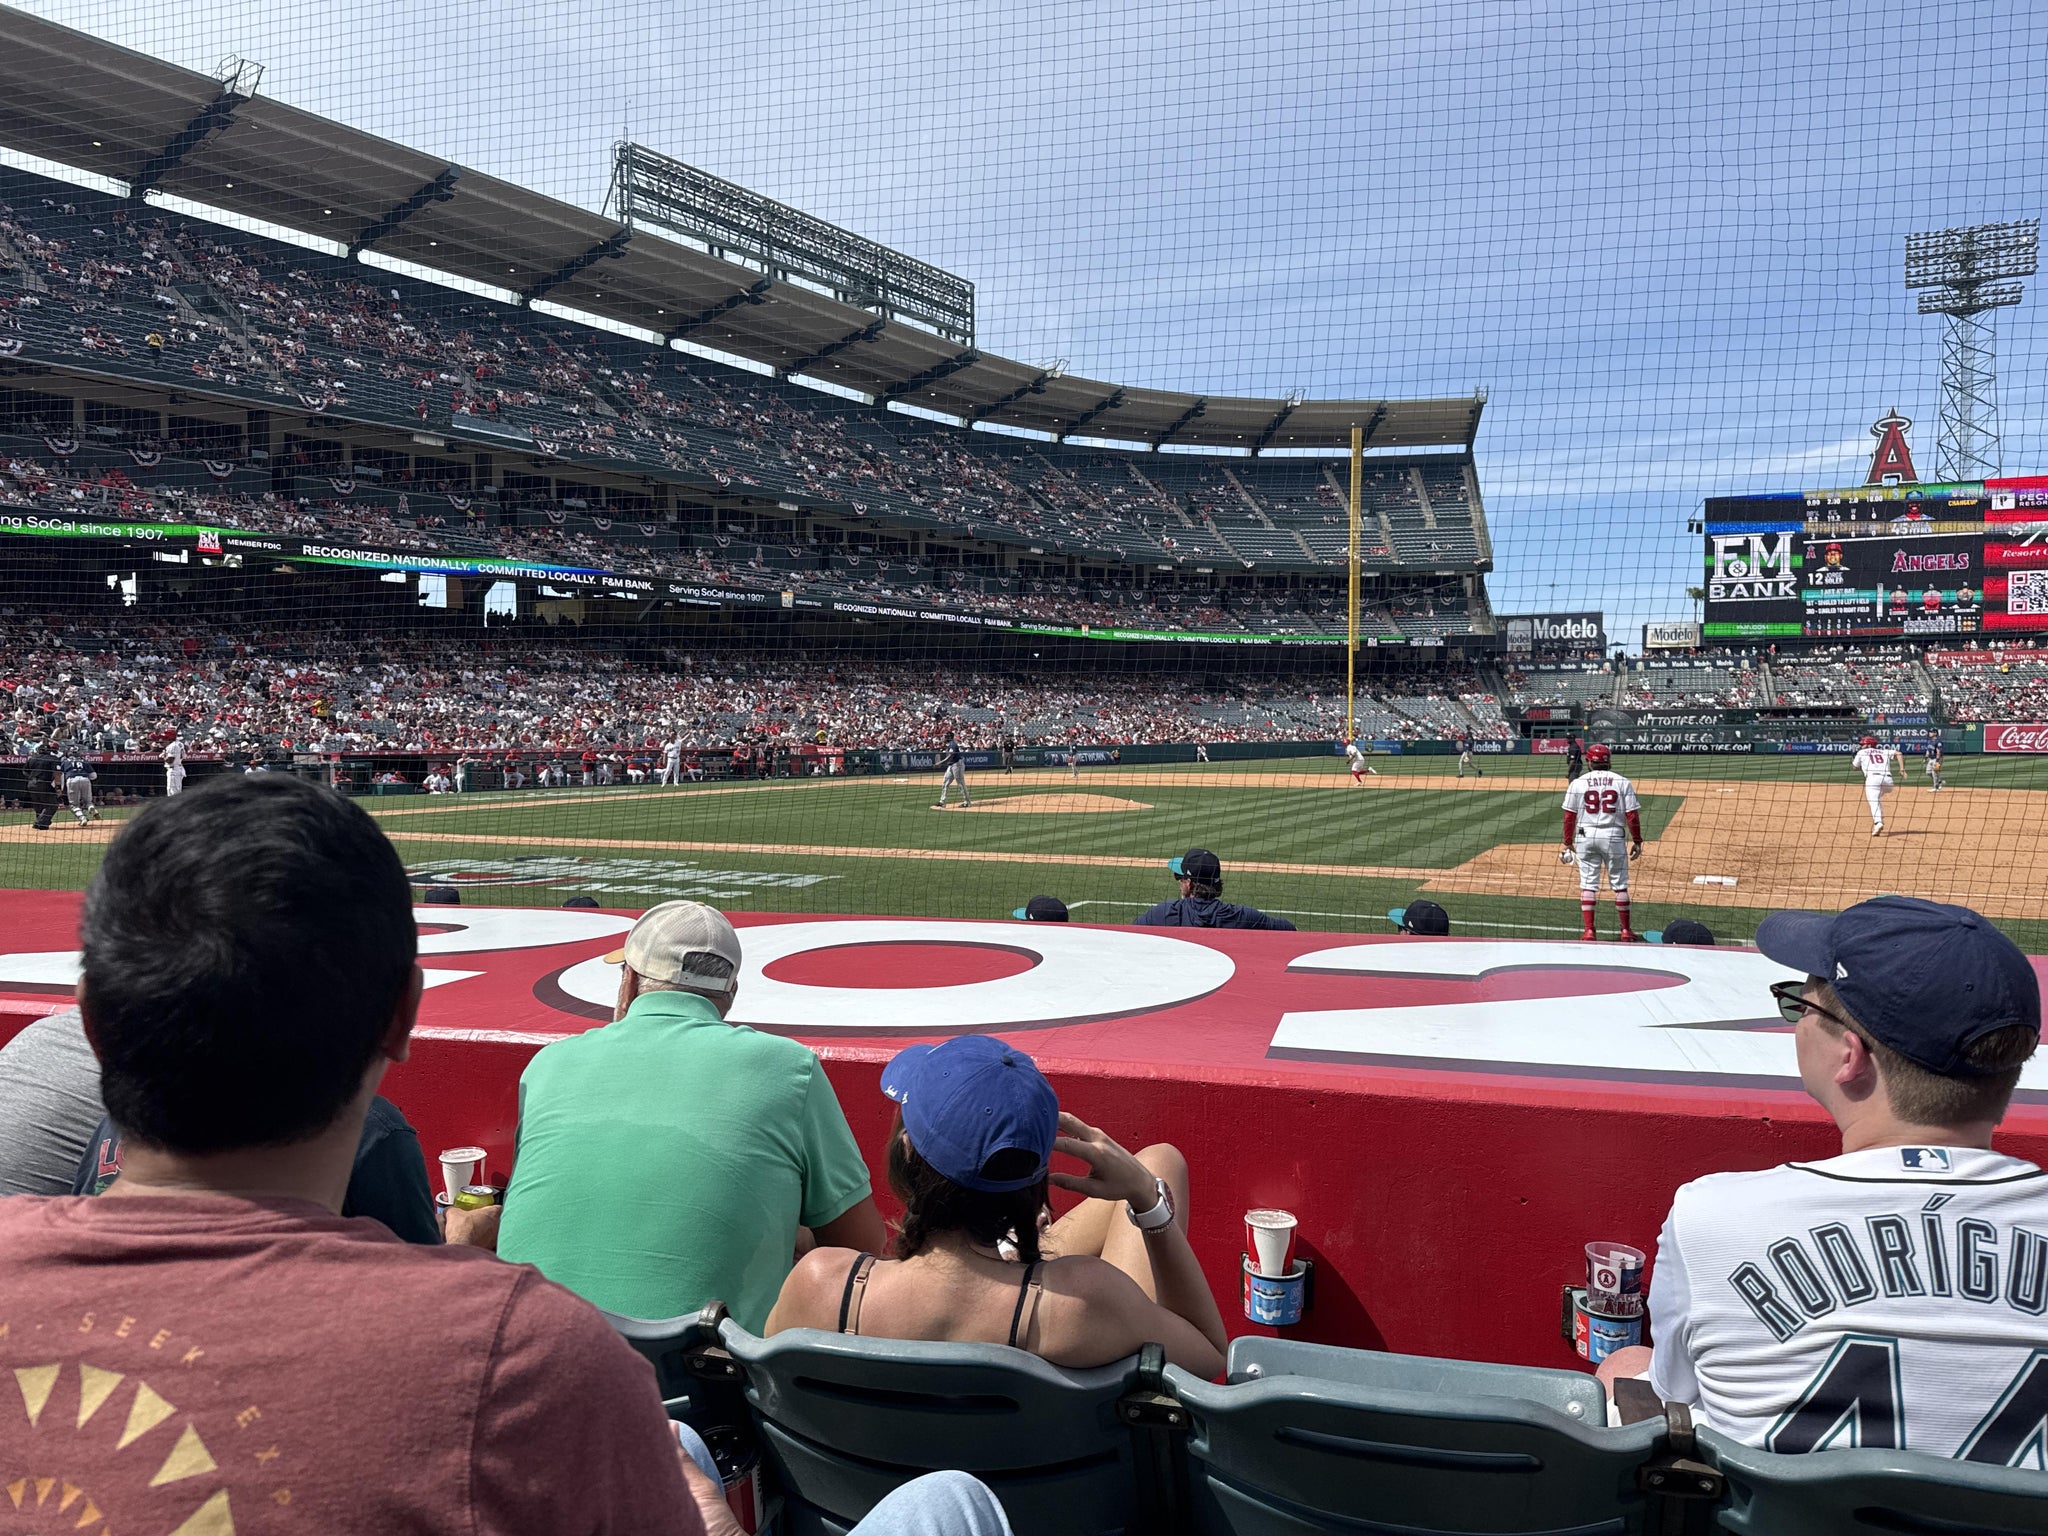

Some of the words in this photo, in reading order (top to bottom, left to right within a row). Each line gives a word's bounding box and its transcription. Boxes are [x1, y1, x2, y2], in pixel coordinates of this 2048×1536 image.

[1862, 406, 1920, 487] A
[27, 516, 76, 532] SoCal
[80, 523, 122, 537] since
[127, 527, 168, 541] 1907.
[227, 538, 262, 548] MEMBER
[263, 541, 282, 550] FDIC
[1711, 531, 1796, 578] F&M
[1891, 548, 1969, 572] ANGELS
[303, 545, 390, 563] RECOGNIZED
[393, 554, 471, 571] NATIONALLY.
[478, 563, 546, 579] COMMITTED
[549, 571, 596, 585] LOCALLY.
[602, 577, 623, 588] F&M
[625, 579, 654, 590] BANK.
[1808, 572, 1824, 585] 12
[669, 584, 700, 597] Serving
[702, 588, 724, 598] SoCal
[725, 591, 745, 600] since
[746, 593, 767, 602] 1907.
[1709, 581, 1797, 599] BANK
[834, 602, 877, 614] RECOGNIZED
[878, 607, 917, 618] NATIONALLY.
[921, 611, 955, 622] COMMITTED
[957, 615, 982, 624] LOCALLY.
[1020, 621, 1037, 631] Serving
[1533, 618, 1597, 640] Modelo
[1654, 627, 1693, 641] Modelo
[1526, 709, 1550, 720] JMG
[1473, 741, 1500, 751] odelo
[1633, 743, 1672, 751] TIRE.COM
[1681, 743, 1708, 751] NITTO
[1710, 743, 1751, 751] TIRE.COM
[910, 755, 932, 767] Modelo
[1869, 754, 1884, 764] 18
[1584, 789, 1618, 814] 92
[78, 1311, 205, 1366] SEEK
